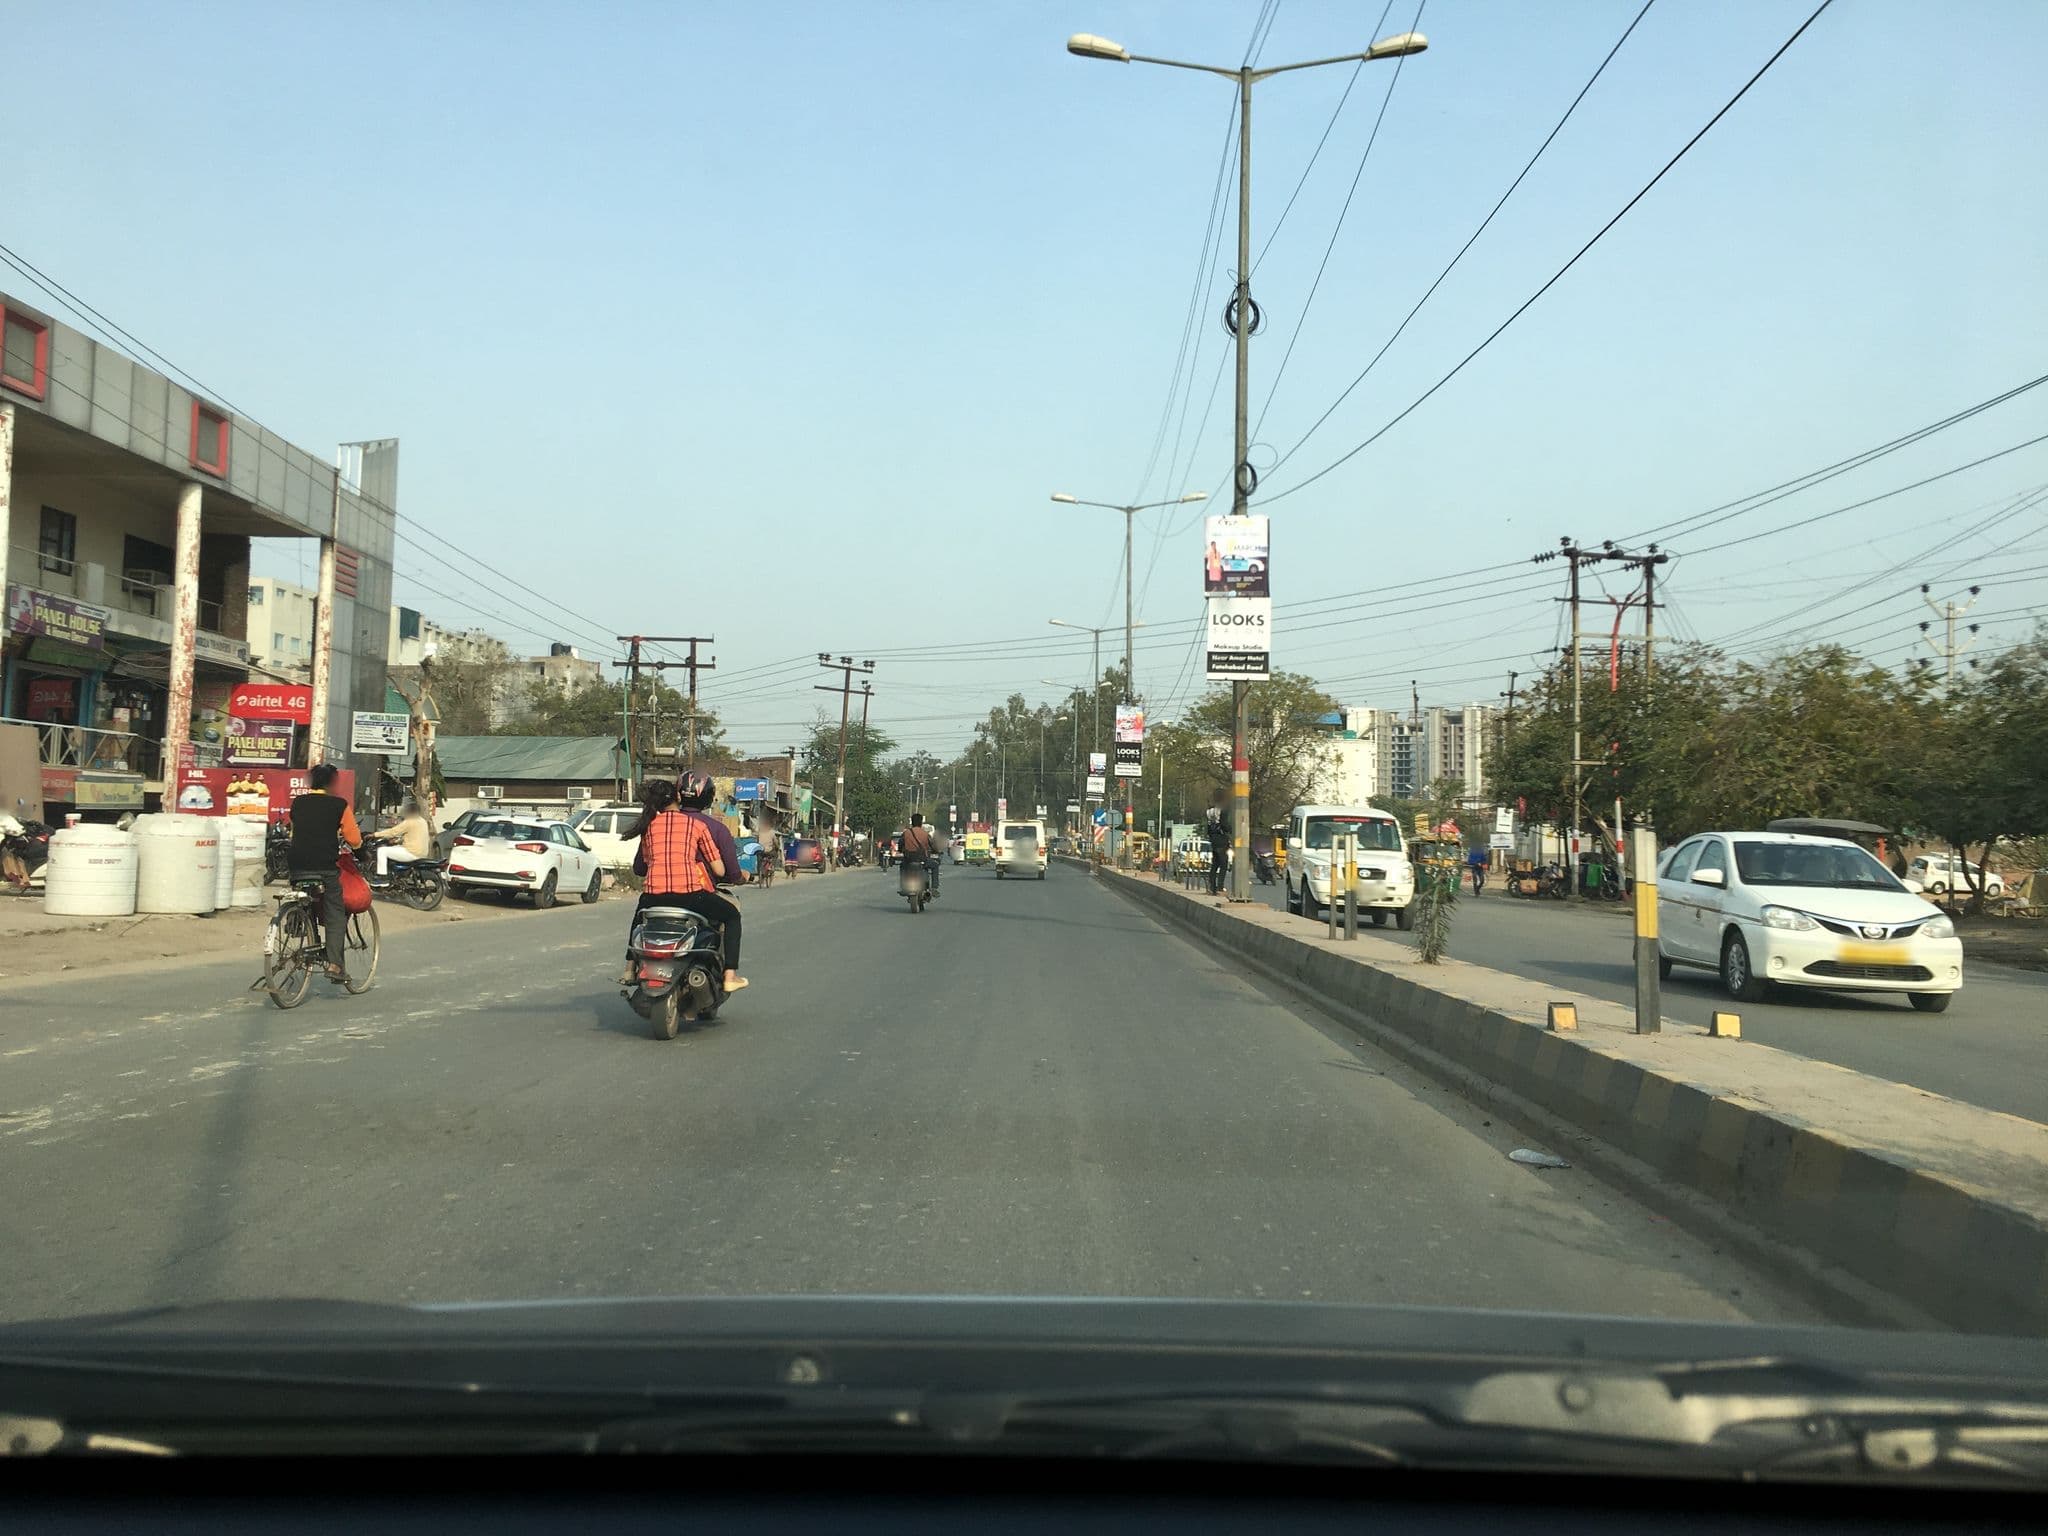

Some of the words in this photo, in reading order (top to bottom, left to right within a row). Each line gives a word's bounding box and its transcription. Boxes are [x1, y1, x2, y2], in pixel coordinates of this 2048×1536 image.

[35, 605, 68, 627] PANEL
[1213, 613, 1265, 626] LOOKS
[248, 694, 282, 707] airtel
[287, 696, 306, 708] 4G
[228, 736, 257, 749] PANEL
